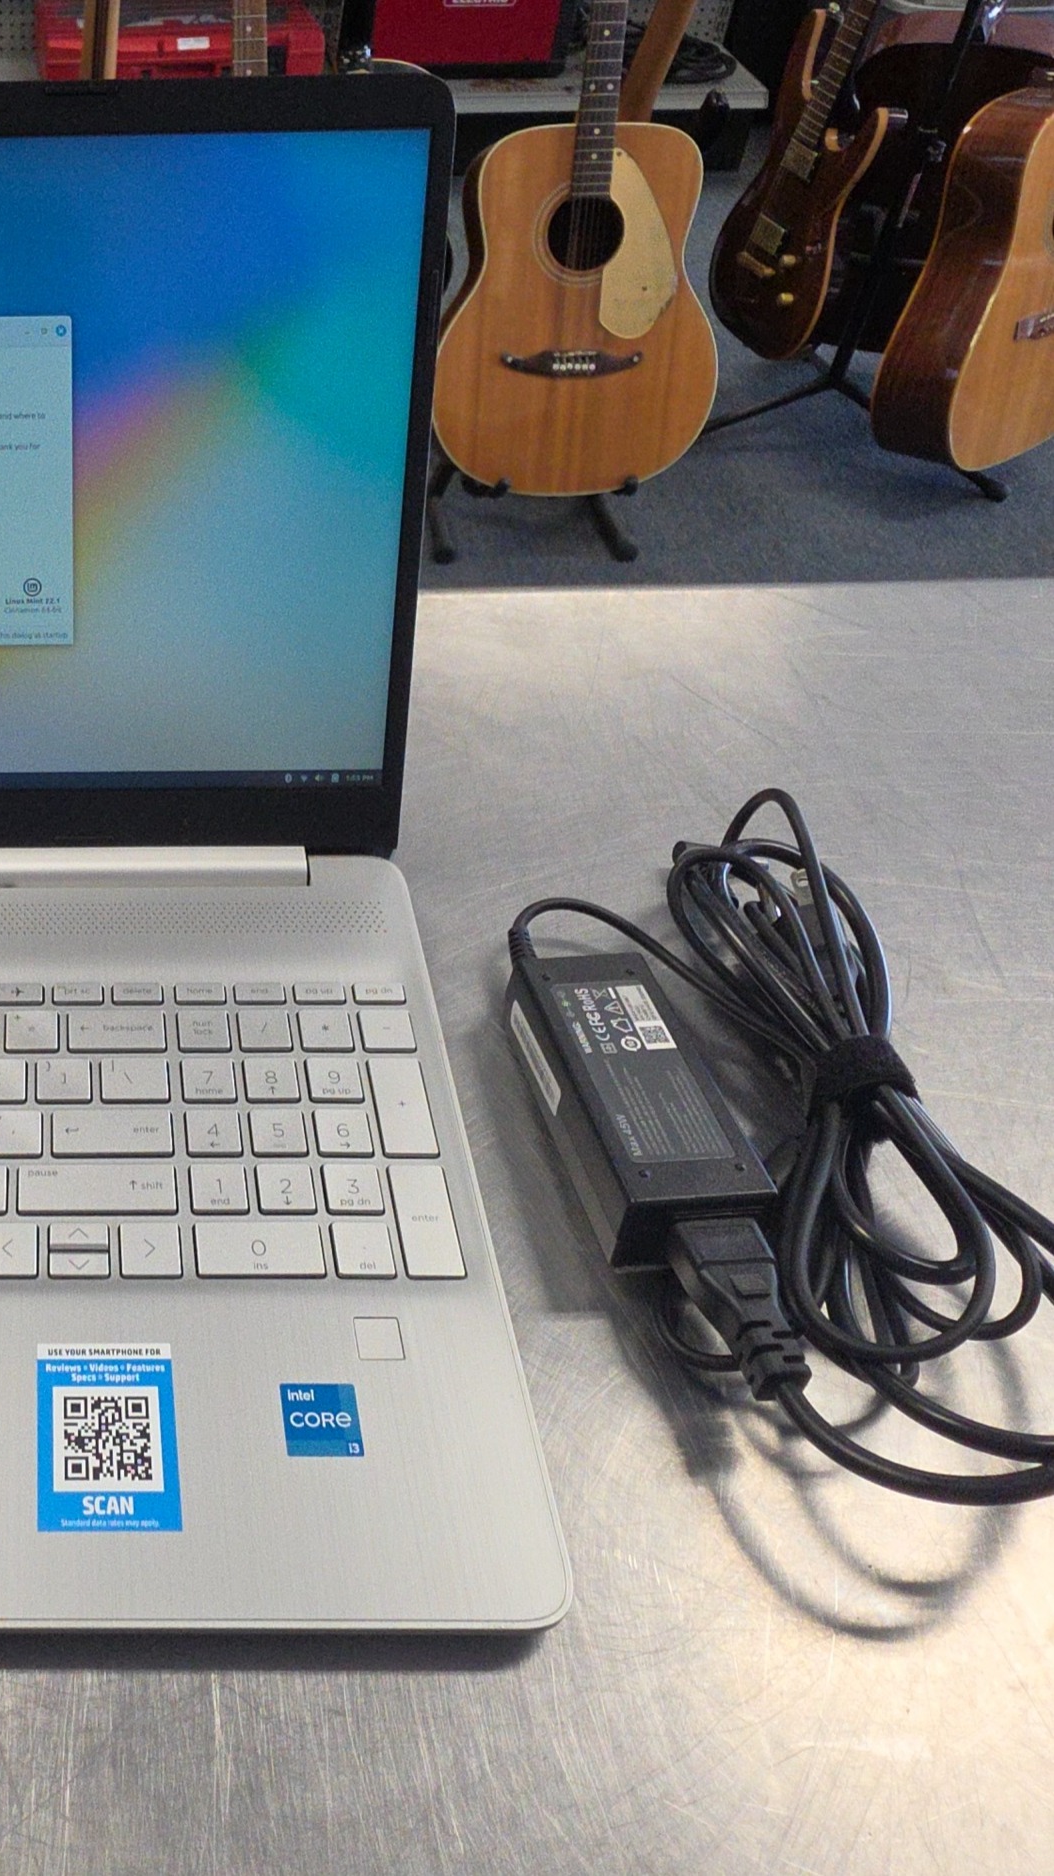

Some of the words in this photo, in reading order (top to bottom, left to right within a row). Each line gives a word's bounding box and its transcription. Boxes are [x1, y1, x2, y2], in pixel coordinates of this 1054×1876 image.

[5, 597, 25, 605] Linux
[574, 987, 597, 1011] RoHS
[103, 1024, 154, 1033] backspace
[192, 1028, 214, 1036] lock
[202, 1071, 214, 1085] 7
[264, 1071, 278, 1084] 8
[327, 1071, 341, 1084] 9
[195, 1087, 223, 1095] home
[322, 1088, 336, 1096] pg
[337, 1088, 351, 1096] up
[133, 1126, 159, 1134] enter
[207, 1124, 219, 1137] 4
[272, 1124, 285, 1138] 5
[337, 1124, 349, 1138] 6
[27, 1169, 58, 1178] pause
[141, 1181, 163, 1190] shift
[279, 1179, 292, 1194] 2
[346, 1179, 360, 1194] 3
[210, 1197, 230, 1206] end
[340, 1198, 354, 1207] pg
[357, 1197, 371, 1205] dn
[411, 1214, 439, 1222] enter
[253, 1261, 268, 1270] ins
[359, 1261, 376, 1270] del
[47, 1348, 63, 1356] USE
[65, 1348, 86, 1356] YOUR
[88, 1348, 143, 1356] SMARTPHONE
[145, 1348, 161, 1356] FOR
[46, 1363, 82, 1372] Reviews
[89, 1363, 119, 1372] Videos
[126, 1363, 165, 1372] Features
[71, 1373, 97, 1382] Specs
[104, 1373, 140, 1382] Support
[82, 1495, 134, 1515] SCAN
[61, 1518, 90, 1527] Standard
[91, 1519, 107, 1527] data
[108, 1519, 124, 1528] rates
[141, 1519, 159, 1529] apply.
